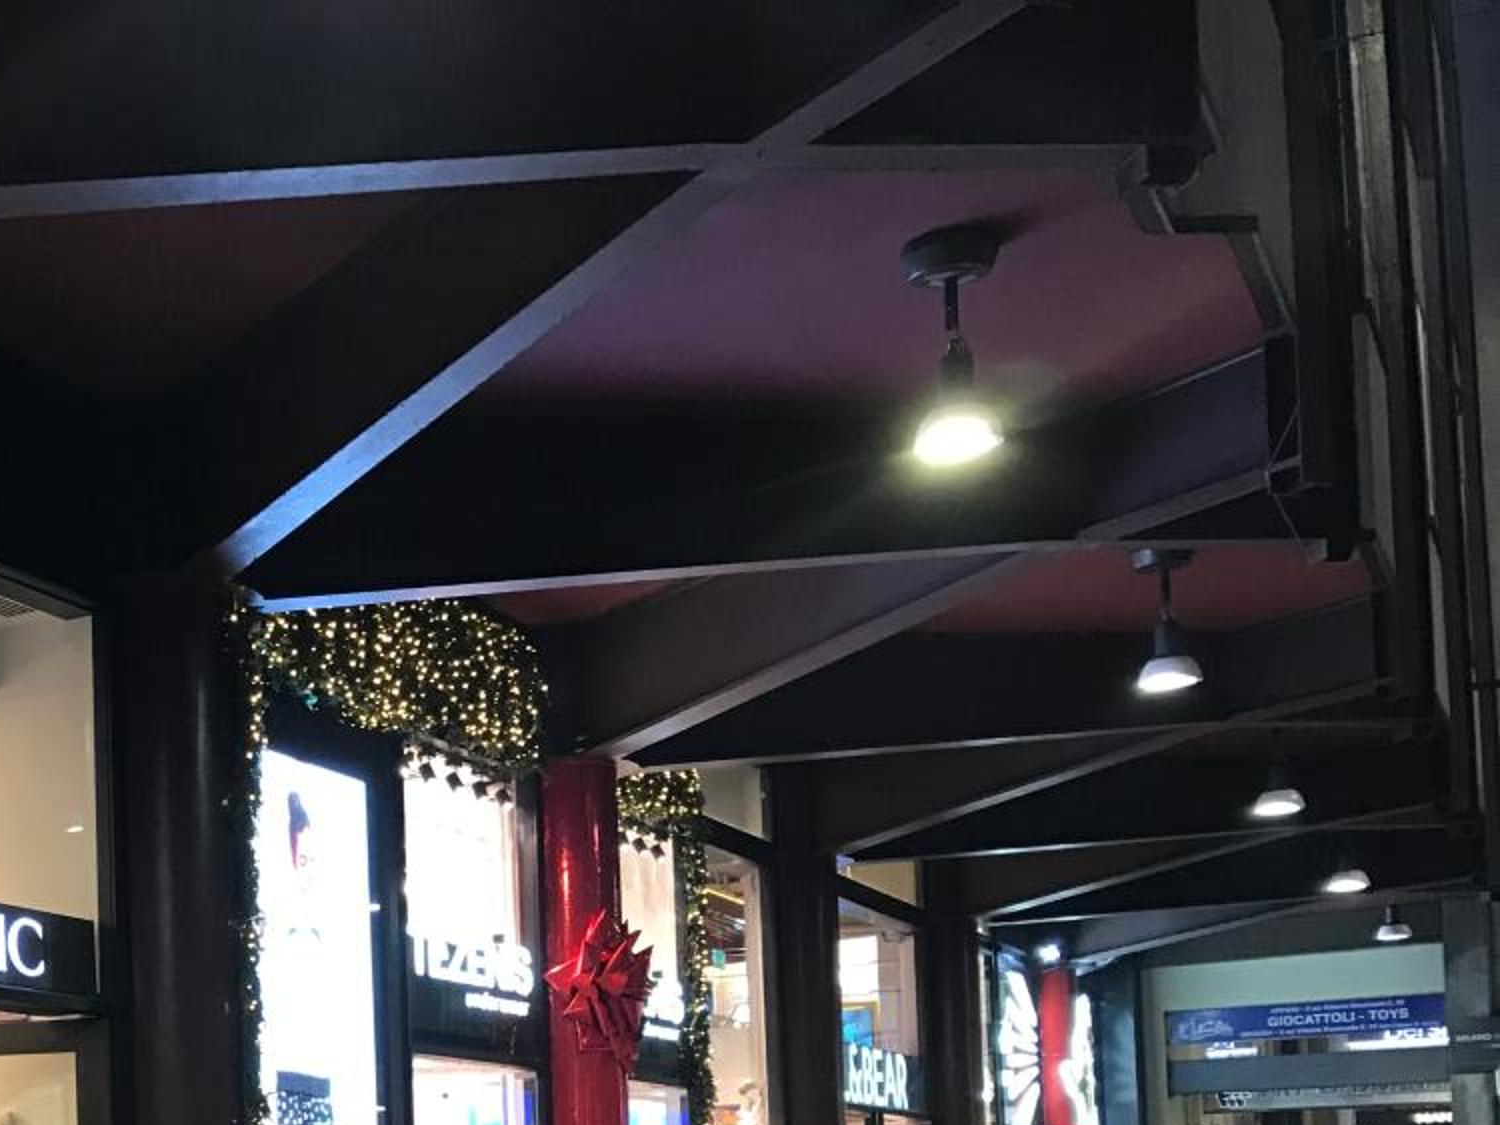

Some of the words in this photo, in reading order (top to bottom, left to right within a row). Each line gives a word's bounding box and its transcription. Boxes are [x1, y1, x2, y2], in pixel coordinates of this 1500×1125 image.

[1267, 1011, 1355, 1027] GIOCATTOLI
[1368, 1007, 1409, 1021] TOYS
[844, 1042, 909, 1110] &BEAR
